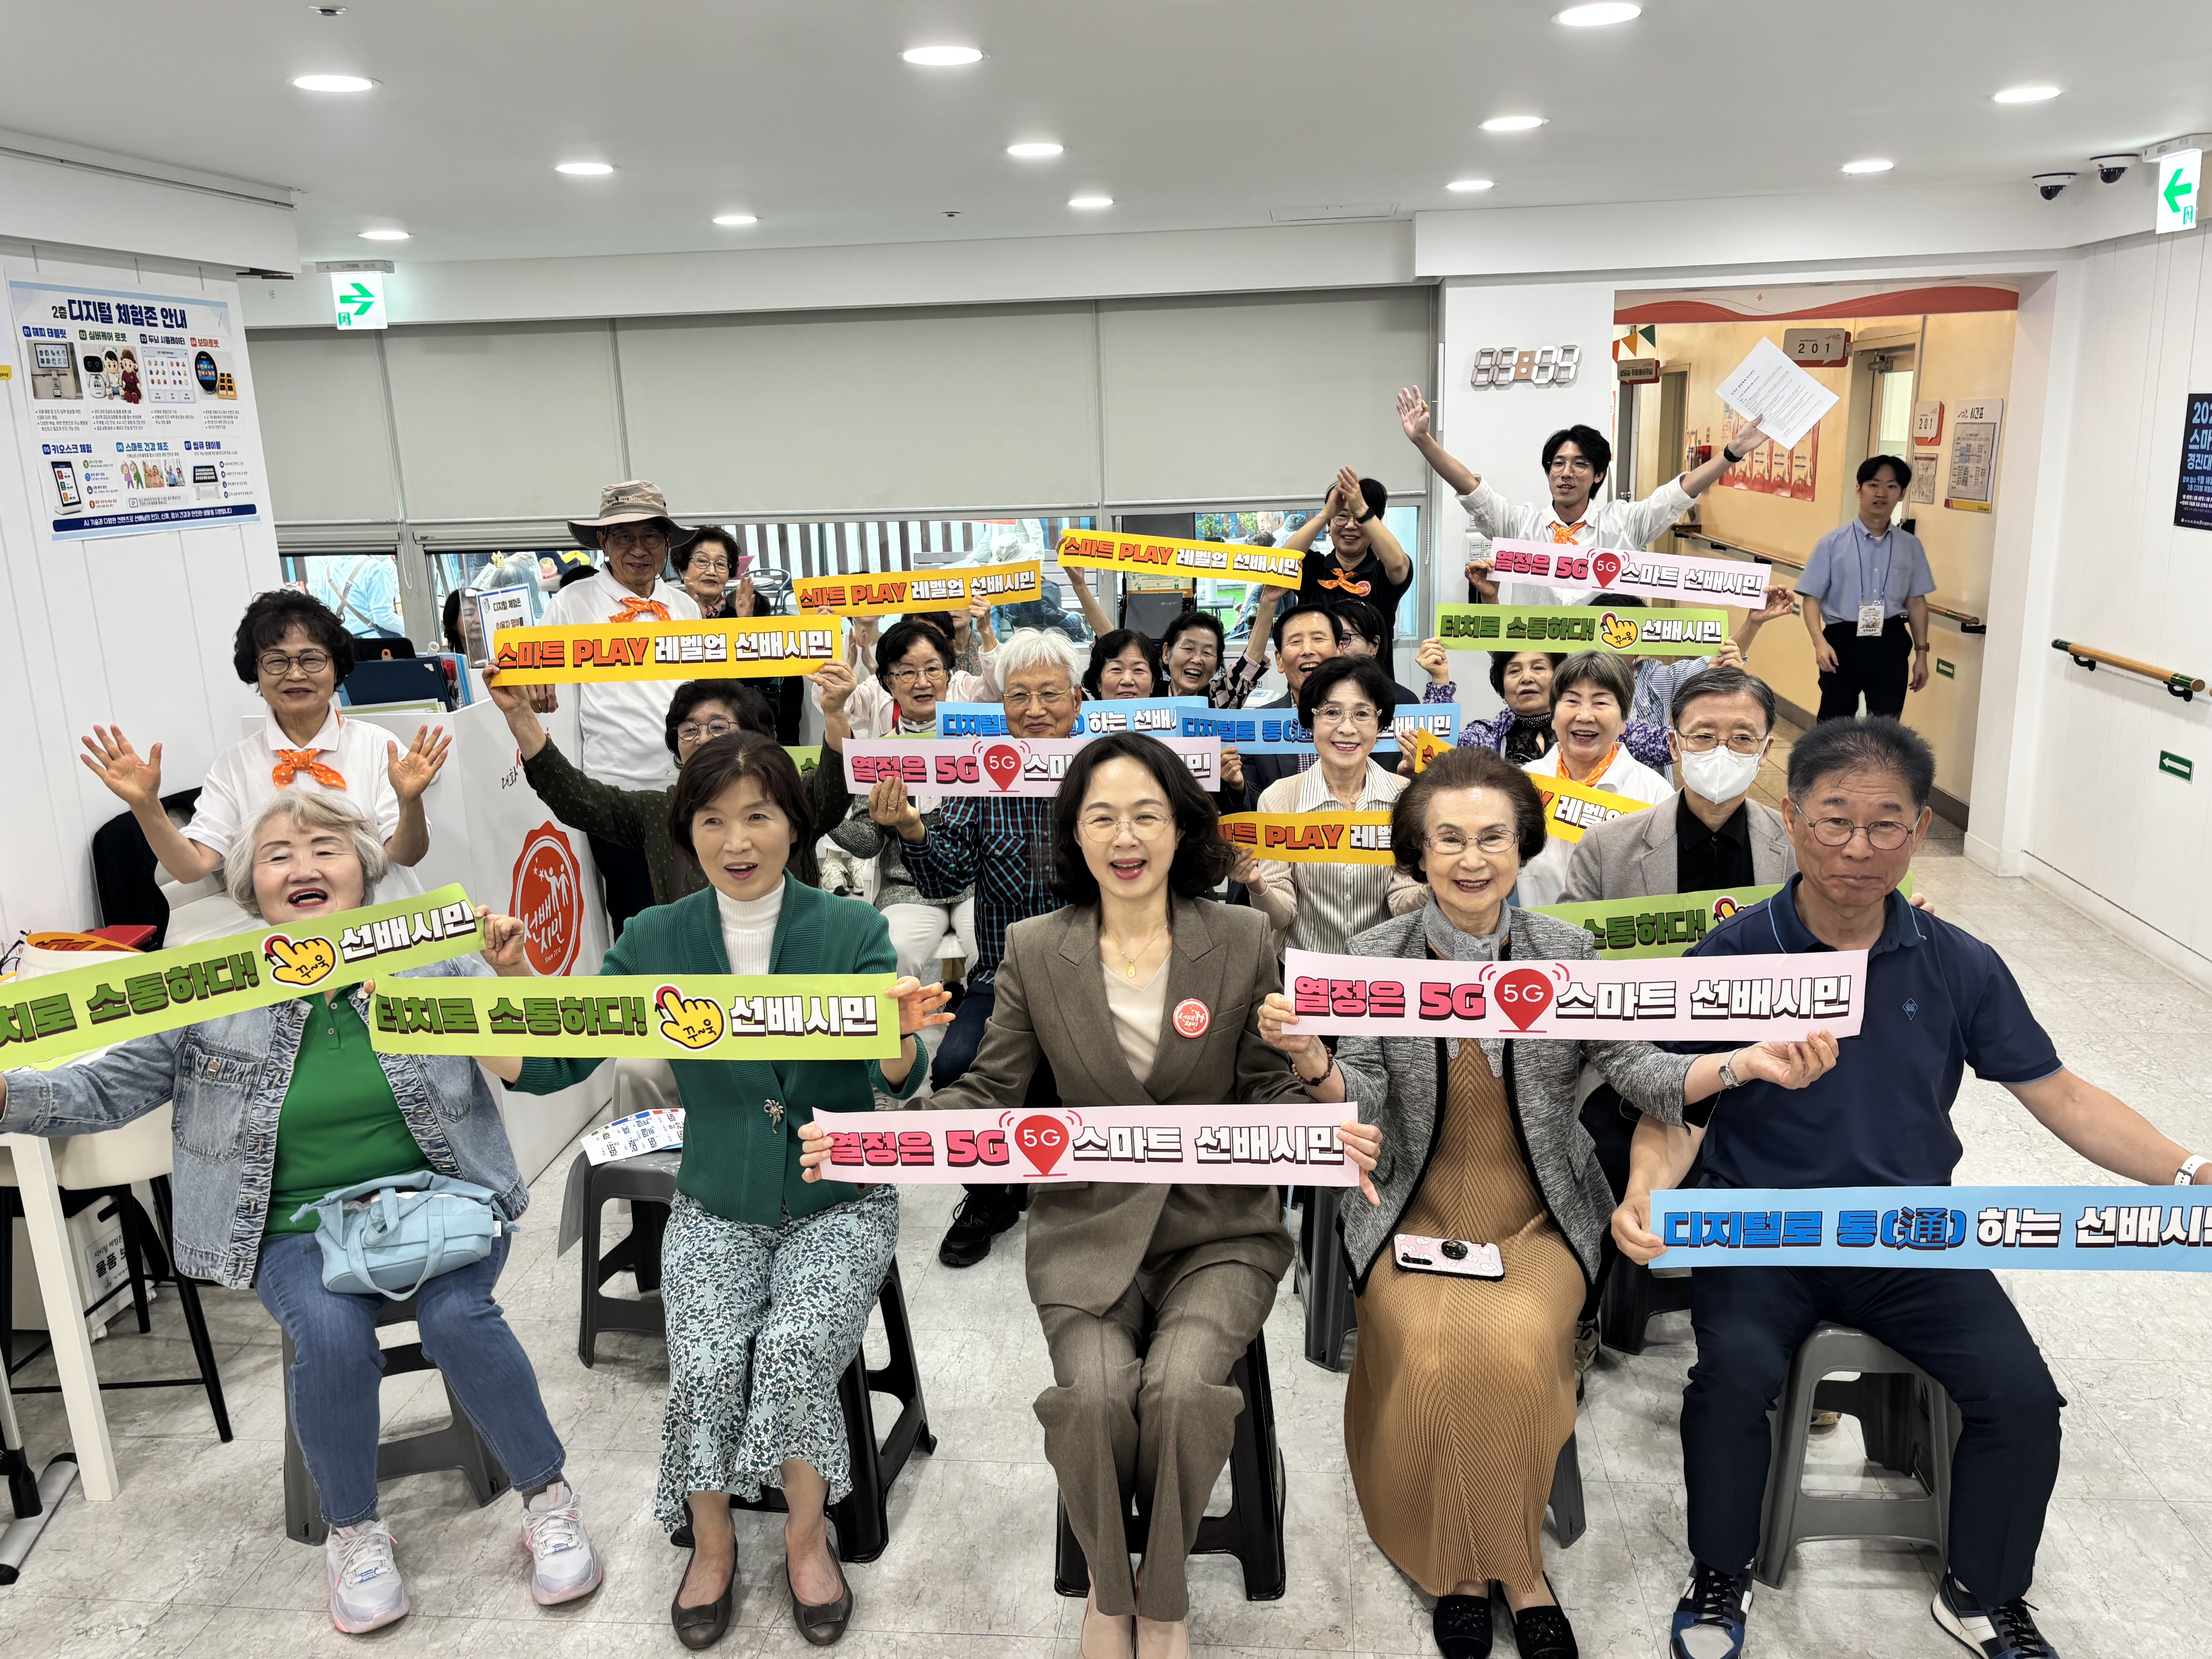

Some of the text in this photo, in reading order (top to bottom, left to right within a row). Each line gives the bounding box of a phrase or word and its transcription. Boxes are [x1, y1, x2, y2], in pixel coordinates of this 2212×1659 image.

[52, 299, 187, 329] 2층 디지털 체험존 안내
[32, 327, 46, 337] 해피
[47, 328, 67, 338] 태블릿
[89, 331, 113, 341] 실버케어
[115, 332, 127, 342] 로봇
[149, 335, 159, 343] 두뇌
[198, 338, 220, 348] 보미로봇
[1798, 343, 1829, 353] 201
[1919, 418, 1932, 429] 201
[52, 444, 79, 454] 키오스크
[79, 444, 93, 453] 체험
[126, 443, 143, 452] 스마트
[144, 442, 156, 451] 건강
[157, 442, 169, 451] 체조
[2189, 429, 2212, 450] 스마
[2187, 453, 2212, 471] 경진대
[1064, 538, 1299, 578] 스마트 PLAY 레벨업 선배시민
[1495, 550, 1763, 598] 열정은 5G 5G 스마트 선배시민
[800, 570, 1036, 608] 스마트 PLAY 레벨업 선배시민
[493, 600, 508, 611] 디지털
[496, 620, 510, 630] 이용자
[1440, 614, 1501, 639] 터치로
[1506, 617, 1595, 641] 소통하다!
[1641, 620, 1722, 644] 선배시민
[498, 630, 833, 670] 스마트 PLAY 레벨업 선배시민
[1089, 711, 1127, 733] 하는
[1133, 708, 1176, 731] 선배
[1182, 718, 1255, 742] 디지털로
[851, 756, 927, 783] 열정은
[936, 756, 980, 784] 5G
[989, 756, 1015, 769] 5G
[1024, 754, 1073, 781] 스마
[1265, 824, 1344, 850] PLAY
[524, 894, 551, 943] 선배
[1583, 909, 1707, 949] 소통하다!
[541, 911, 564, 953] 시민
[545, 953, 553, 963] Since
[0, 993, 78, 1048] 치로
[88, 951, 260, 1025] 소통하다!
[338, 899, 476, 964] 선배시민
[1293, 974, 1852, 1021] 열정은 5G 5G 스마트 선배시민
[375, 993, 479, 1035] 터치로
[488, 996, 647, 1037] 소통하다!
[729, 996, 879, 1037] 선배시민
[828, 1125, 1345, 1167] 열정은 5G 5G 스마트 선배시민
[1663, 1211, 1822, 1249] 디지털로
[1978, 1207, 2061, 1248] 하는
[2075, 1205, 2212, 1248] 선배시
[96, 1252, 117, 1278] 물품
